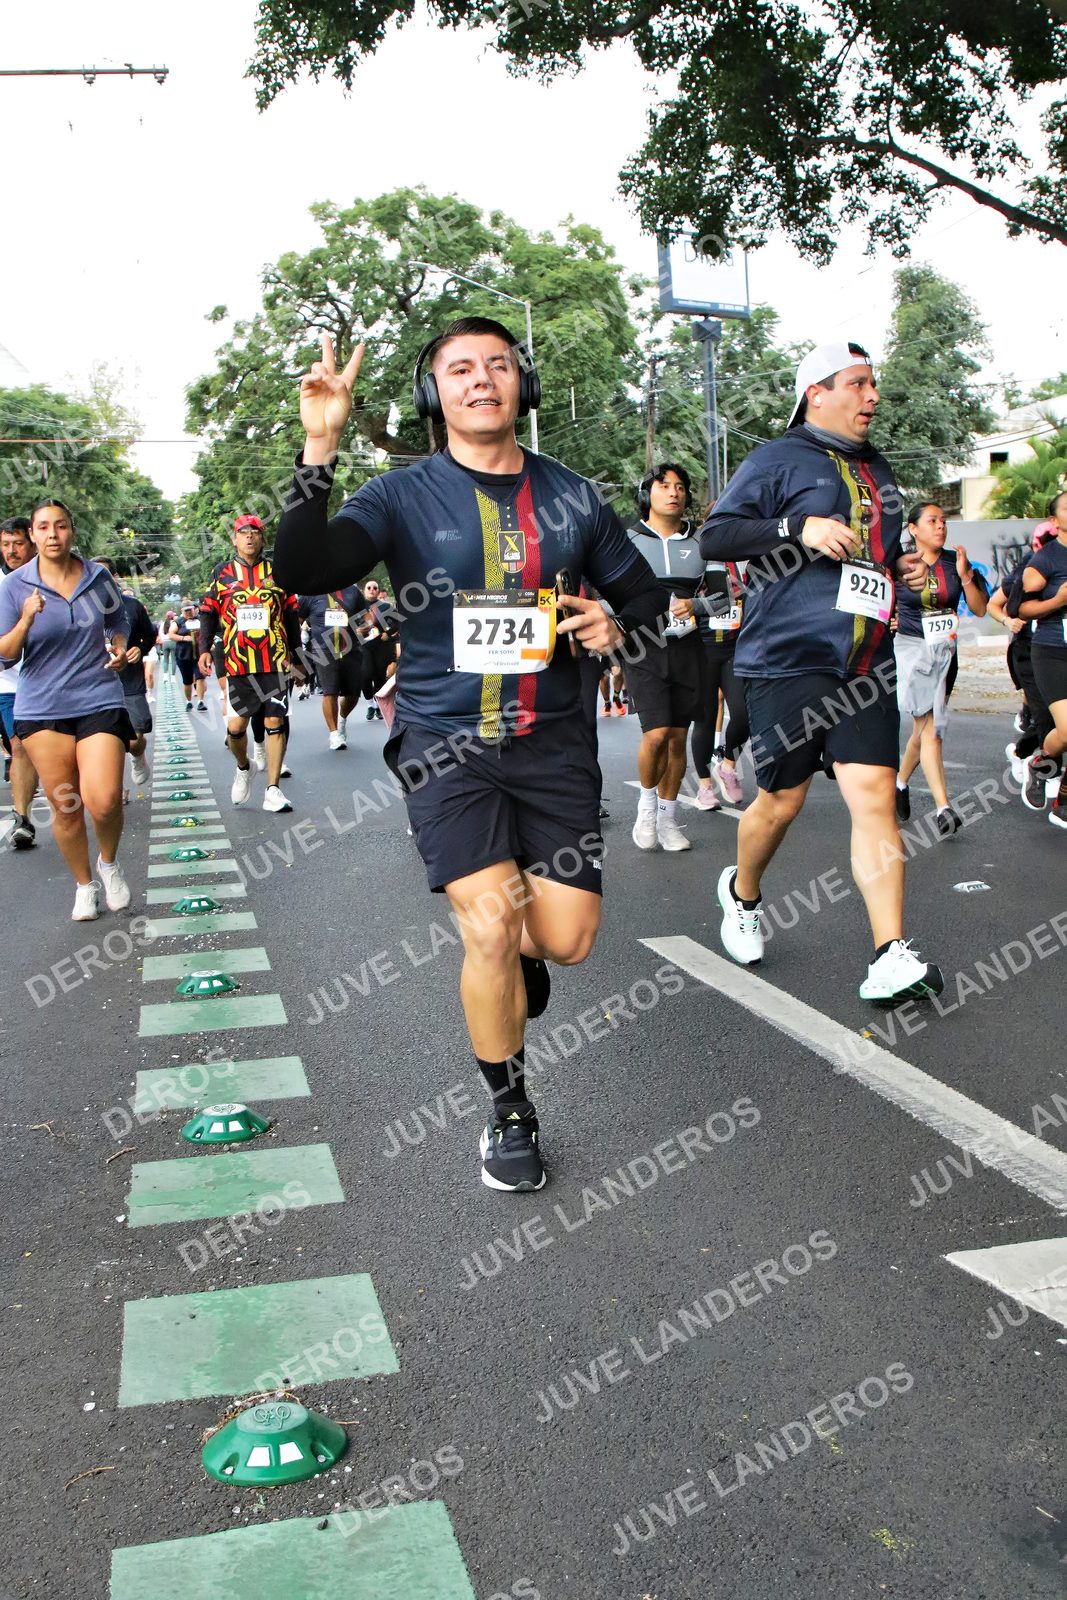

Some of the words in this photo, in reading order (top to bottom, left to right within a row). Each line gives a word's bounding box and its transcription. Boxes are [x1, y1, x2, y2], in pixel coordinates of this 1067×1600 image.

[850, 573, 885, 600] 9221
[540, 596, 552, 605] 5K
[241, 611, 263, 621] 4493
[467, 618, 535, 645] 2734
[928, 618, 953, 632] 7579
